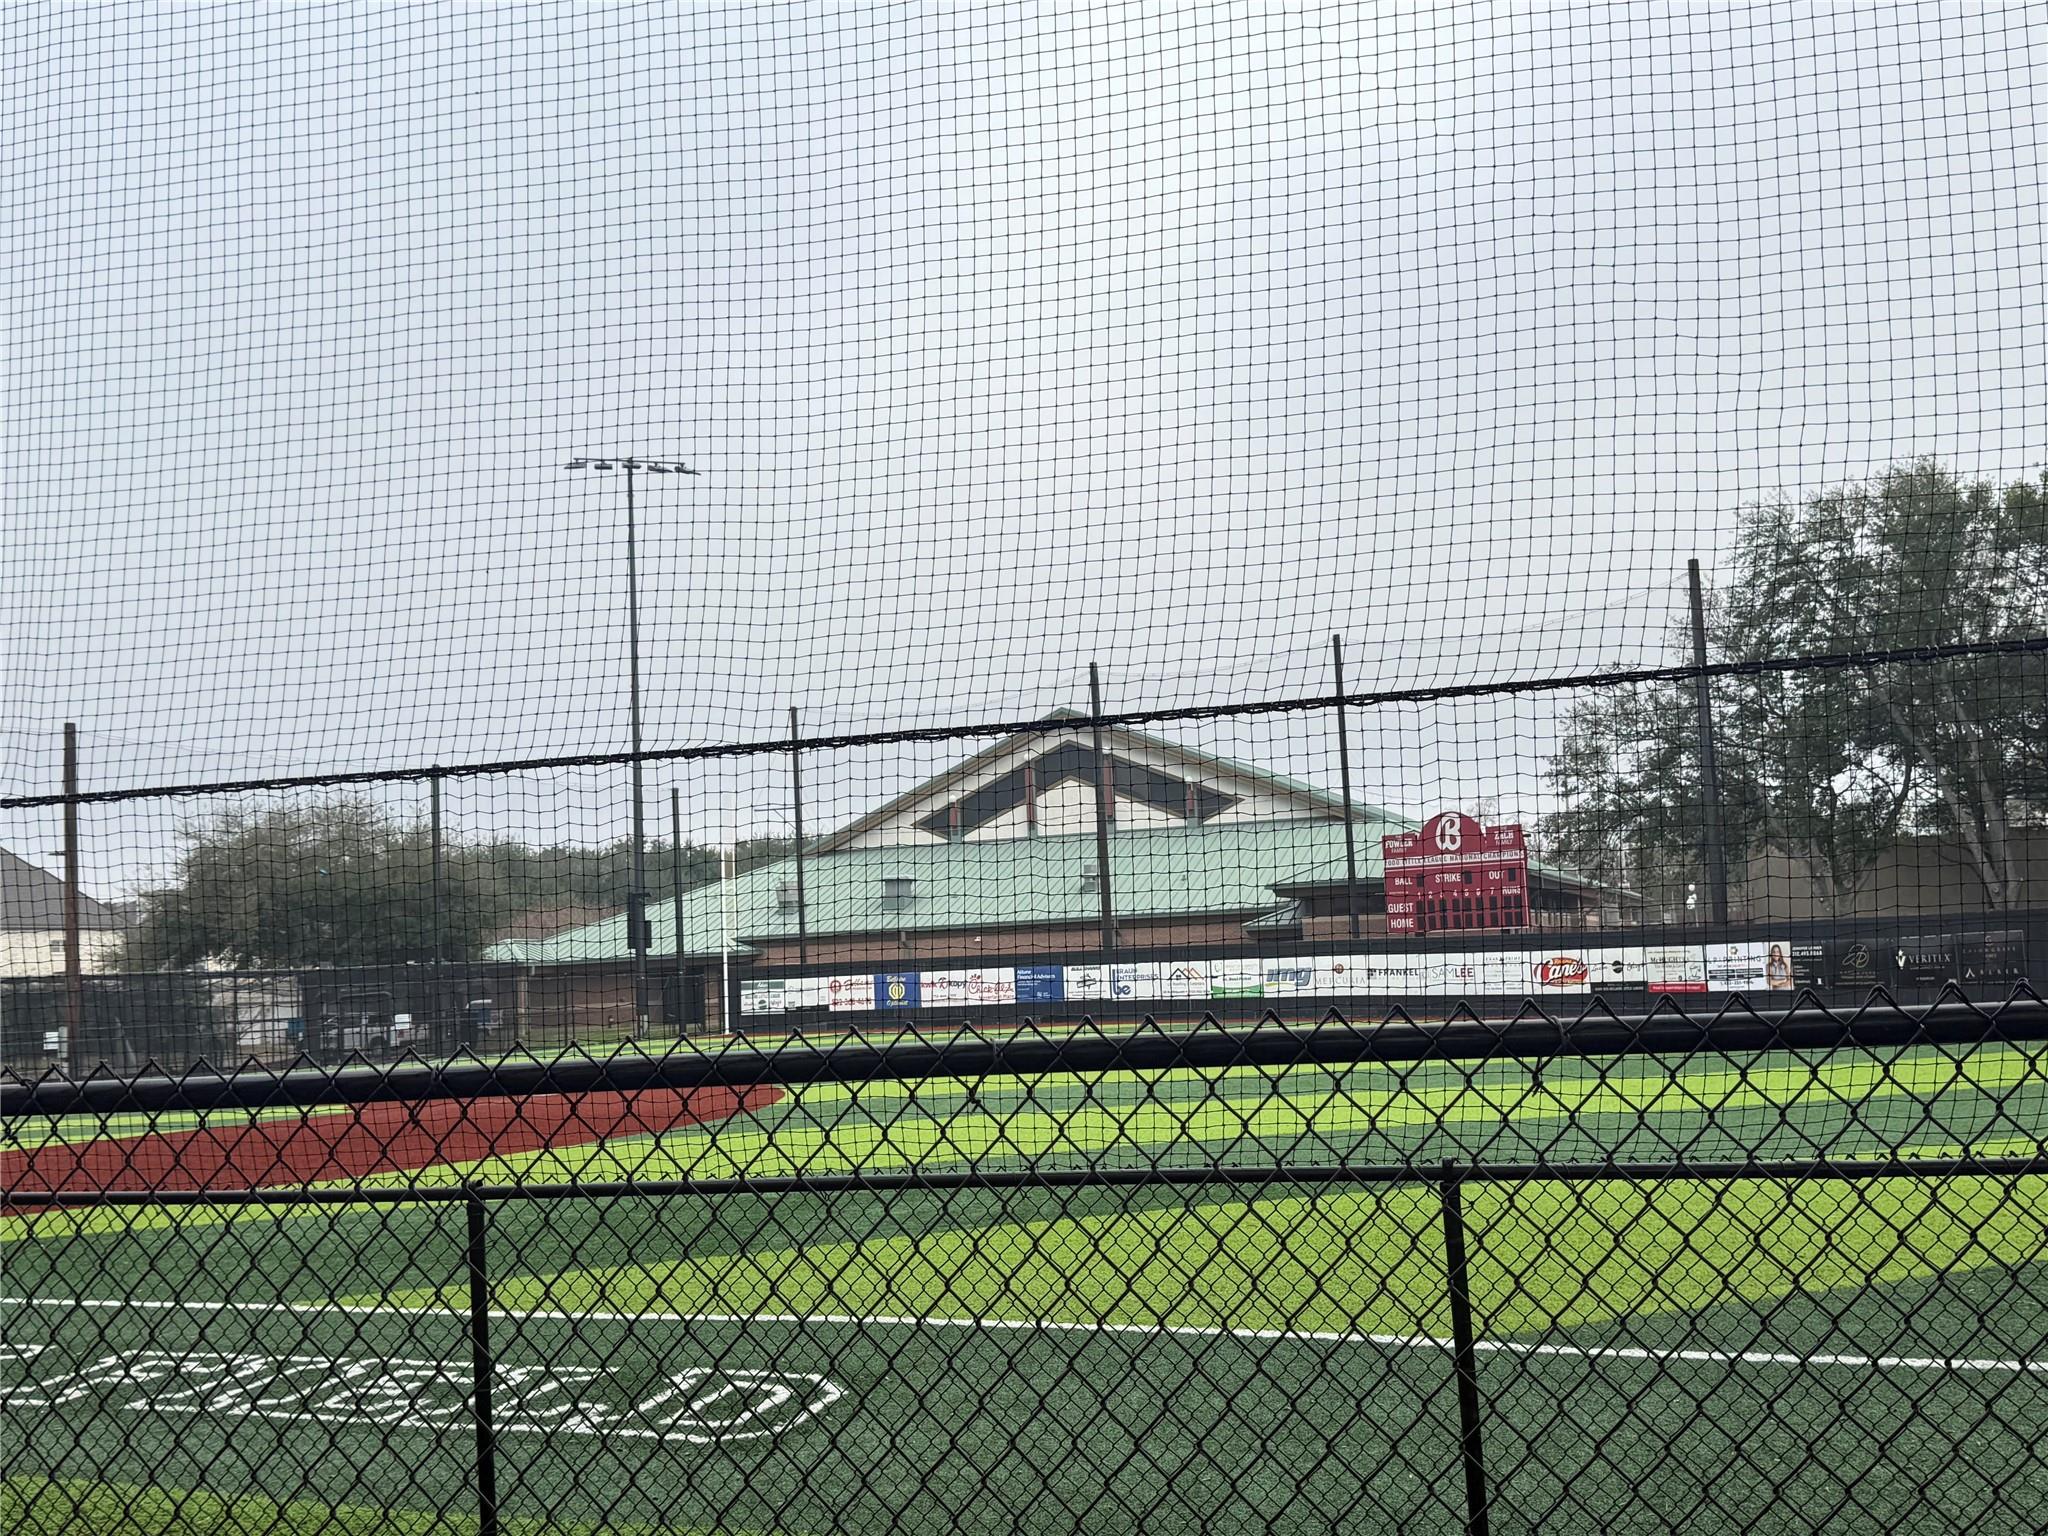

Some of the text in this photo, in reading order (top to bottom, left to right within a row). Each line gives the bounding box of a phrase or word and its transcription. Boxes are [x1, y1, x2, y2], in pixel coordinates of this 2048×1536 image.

[1385, 838, 1414, 849] FOWLER
[1394, 870, 1505, 885] BALL STRIKE OUT
[1417, 892, 1421, 900] 1
[1428, 890, 1433, 899] 2
[1489, 886, 1495, 895] 7
[1388, 903, 1414, 914] GUEST
[1391, 918, 1414, 929] HOME
[1378, 969, 1419, 977] FRANKEL
